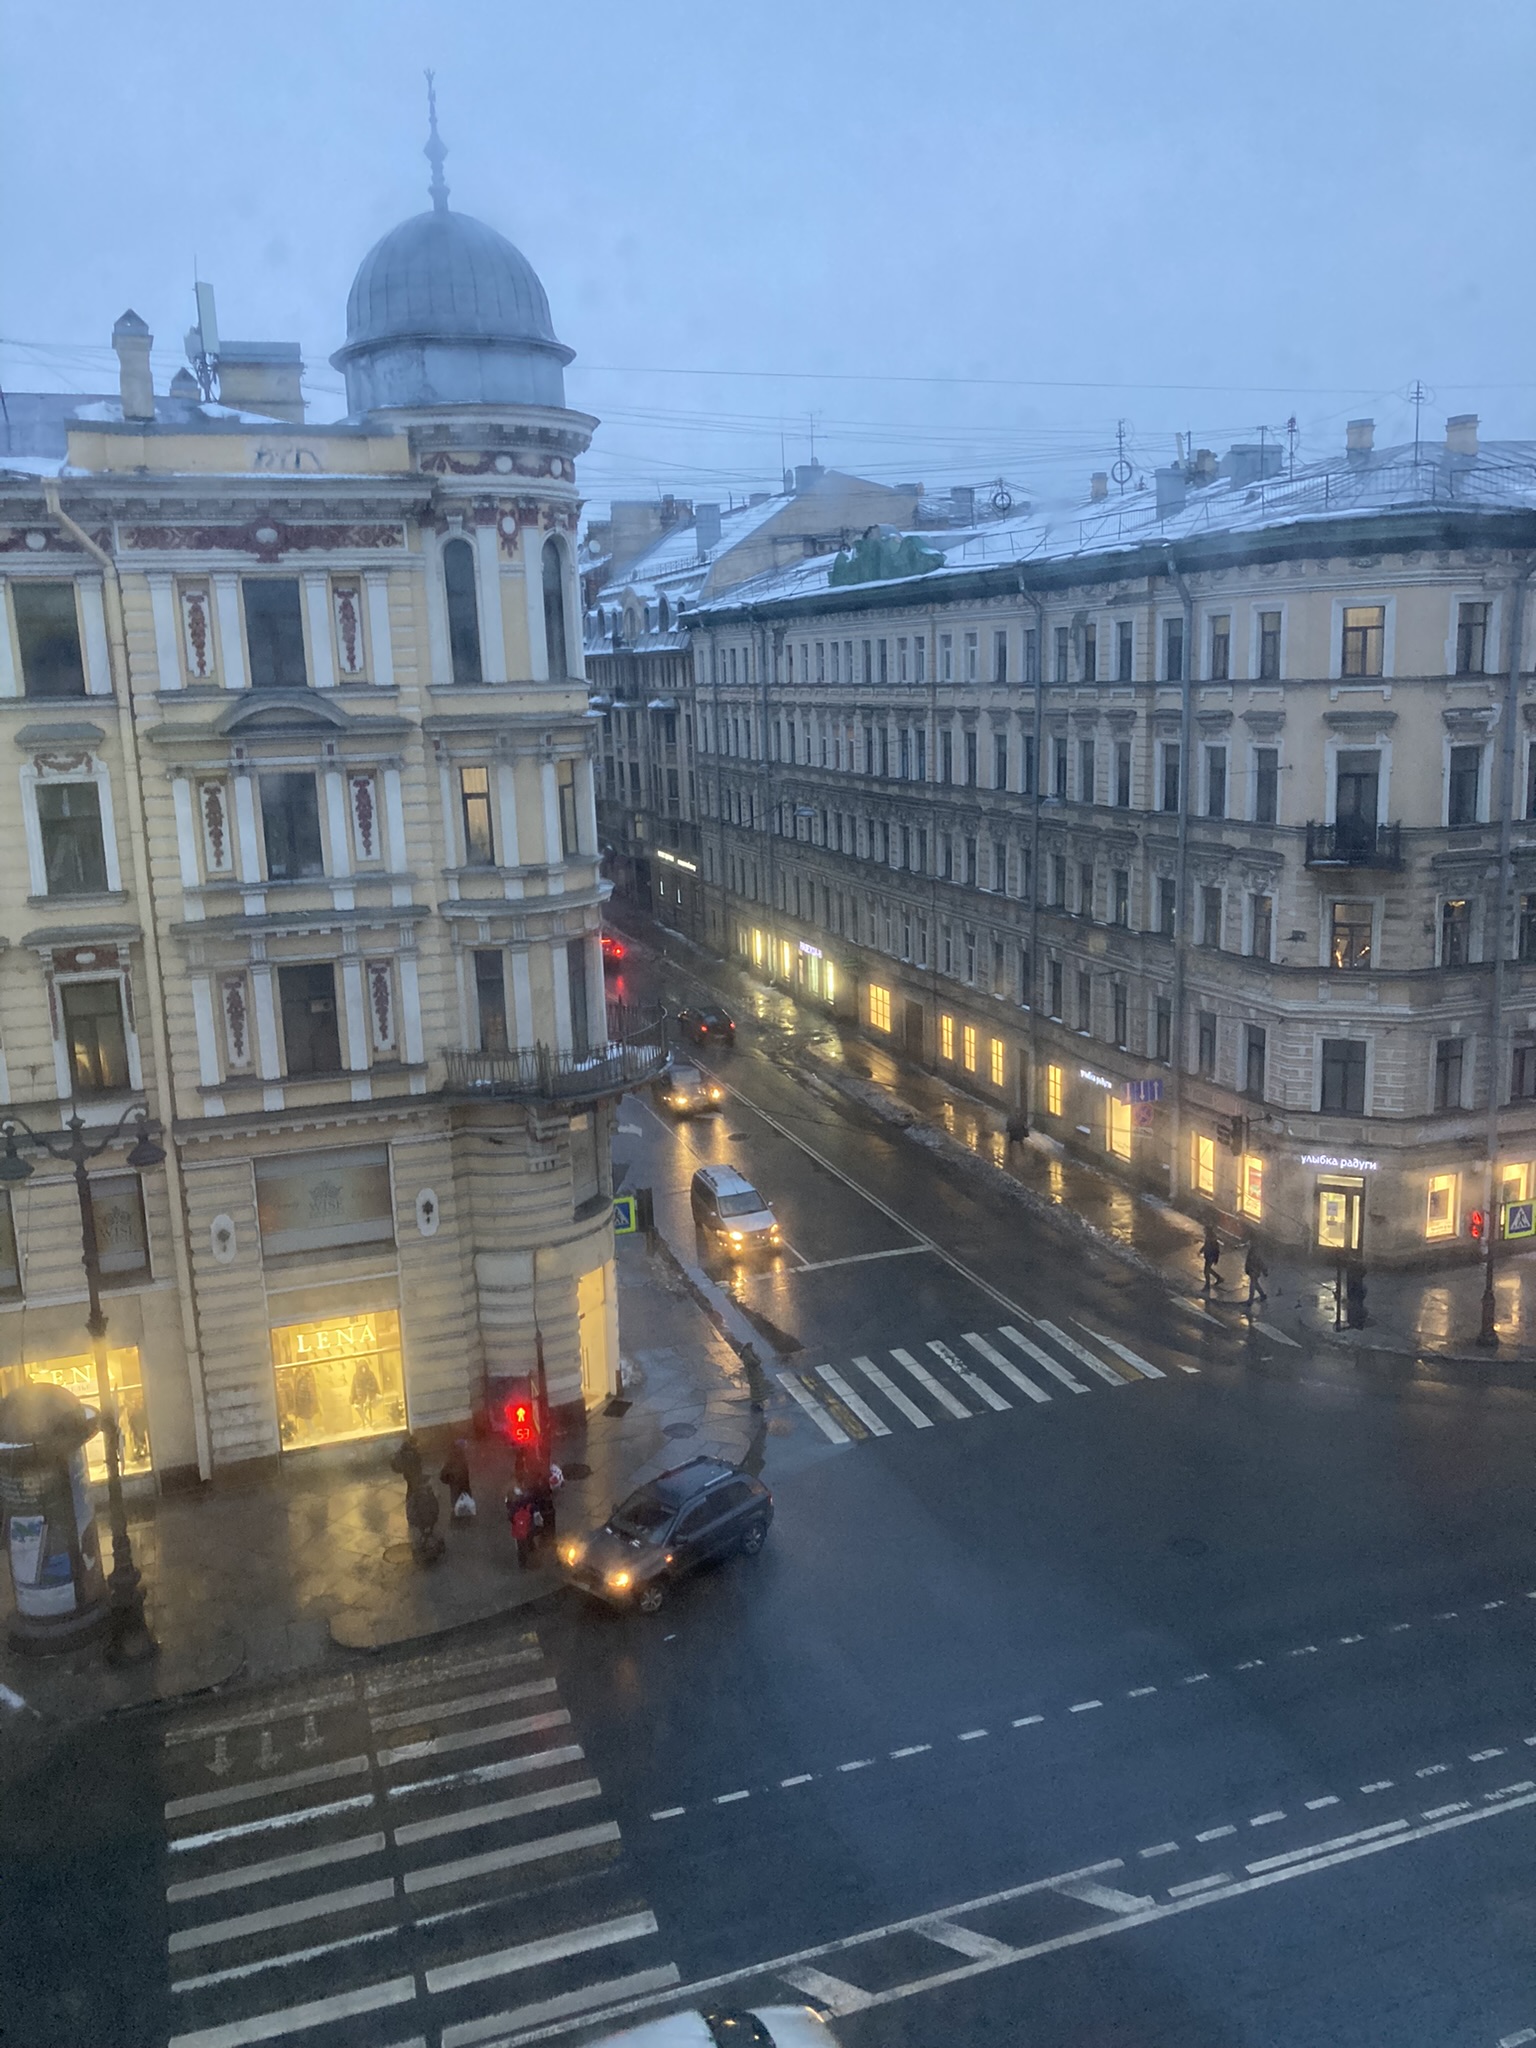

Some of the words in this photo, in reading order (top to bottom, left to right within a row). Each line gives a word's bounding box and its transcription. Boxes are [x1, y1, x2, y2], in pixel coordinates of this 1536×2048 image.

[1300, 1155, 1338, 1166] улыбка
[1340, 1158, 1377, 1171] радуги
[297, 1325, 376, 1353] LENA
[516, 1428, 530, 1440] 53
